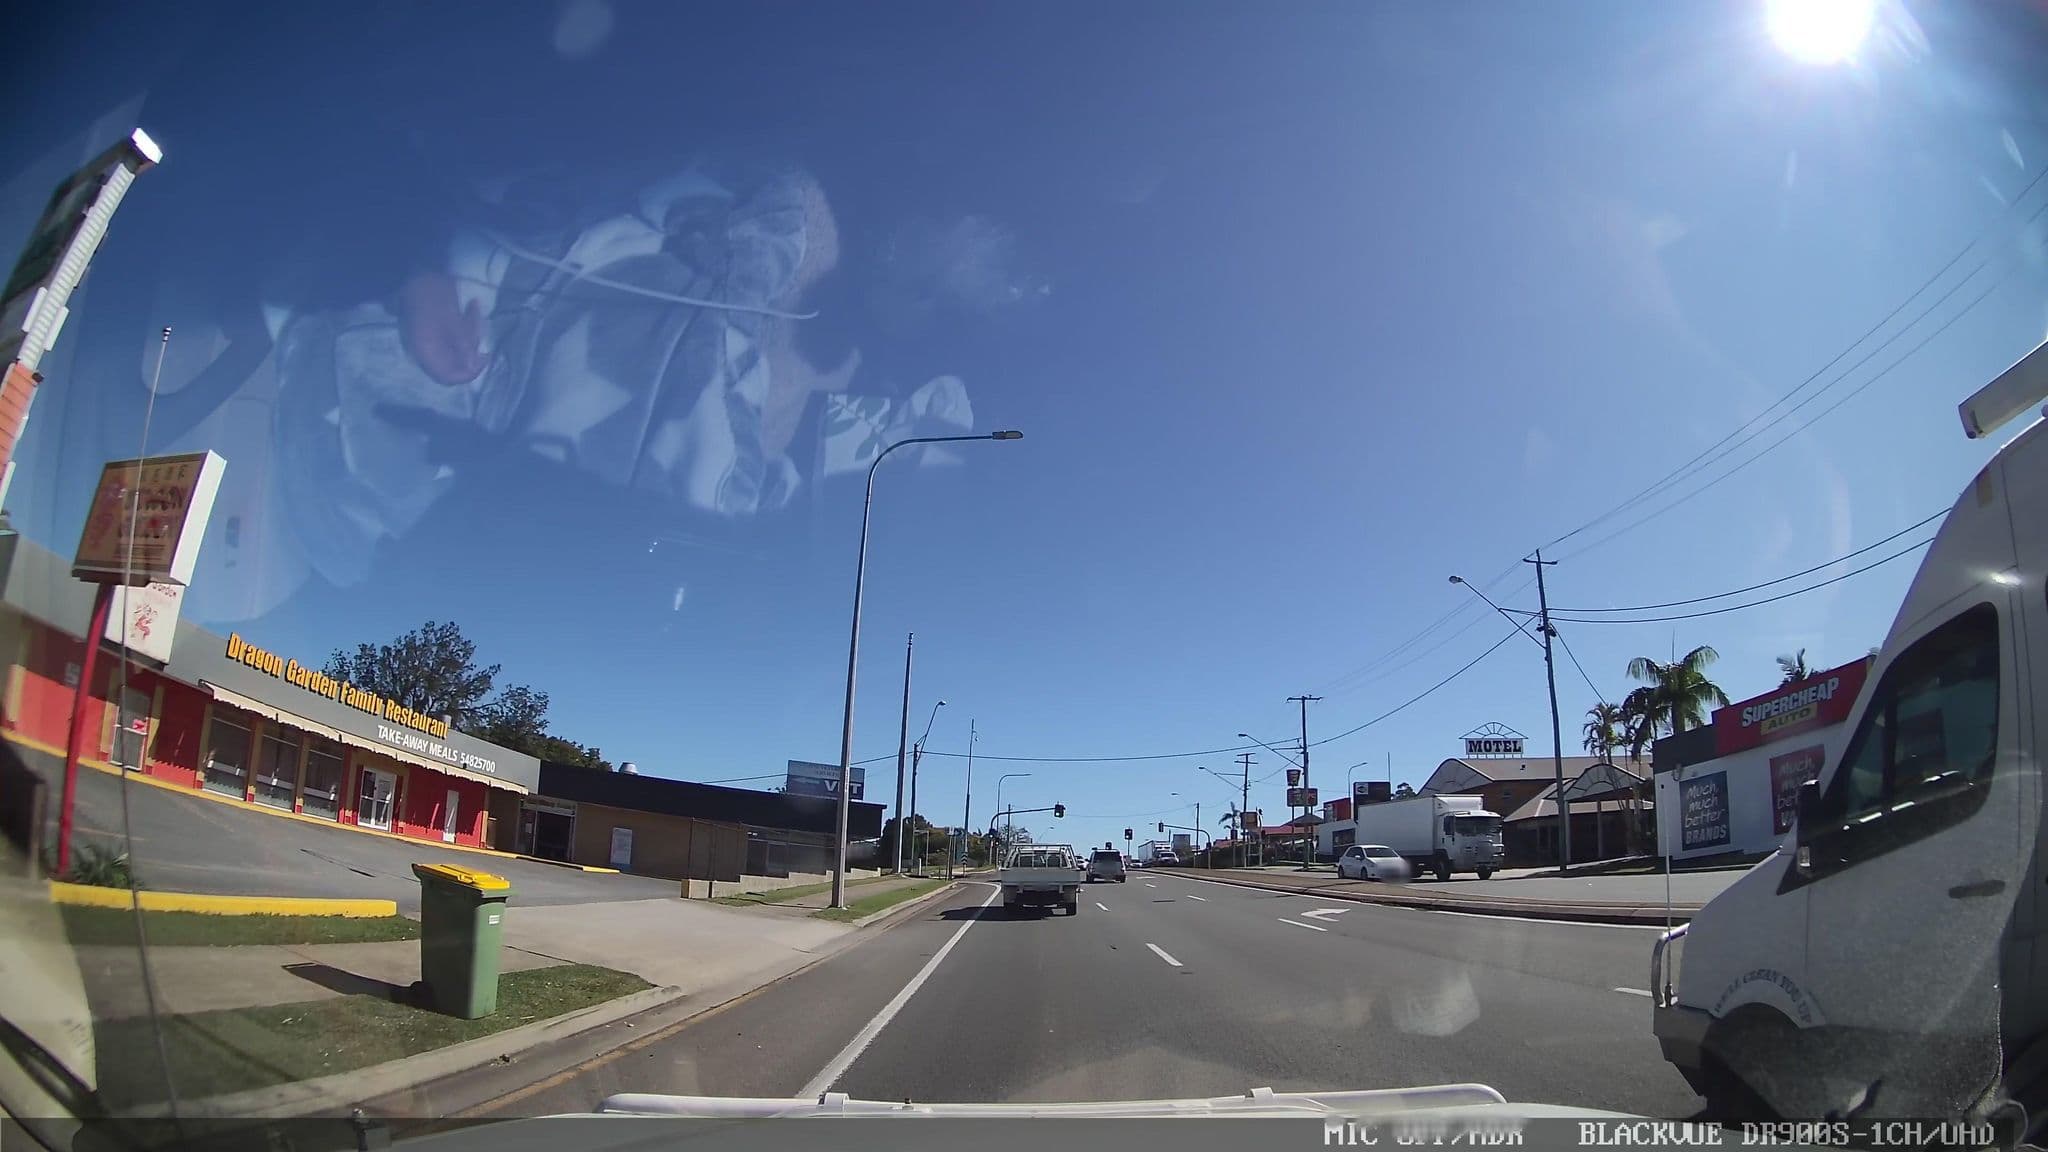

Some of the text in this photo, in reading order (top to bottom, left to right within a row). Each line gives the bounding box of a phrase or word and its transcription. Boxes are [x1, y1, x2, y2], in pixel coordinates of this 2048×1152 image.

[226, 632, 449, 739] Dragon Garden Family Restaurant
[1742, 677, 1840, 727] SUPERCHEAP
[1767, 707, 1811, 730] AUTO
[377, 725, 496, 773] TAKE-AWAY MEALS 54825700
[1468, 740, 1522, 753] MOTEL
[824, 779, 862, 795] VT
[1684, 808, 1726, 828] better
[1686, 824, 1728, 844] BRANDS
